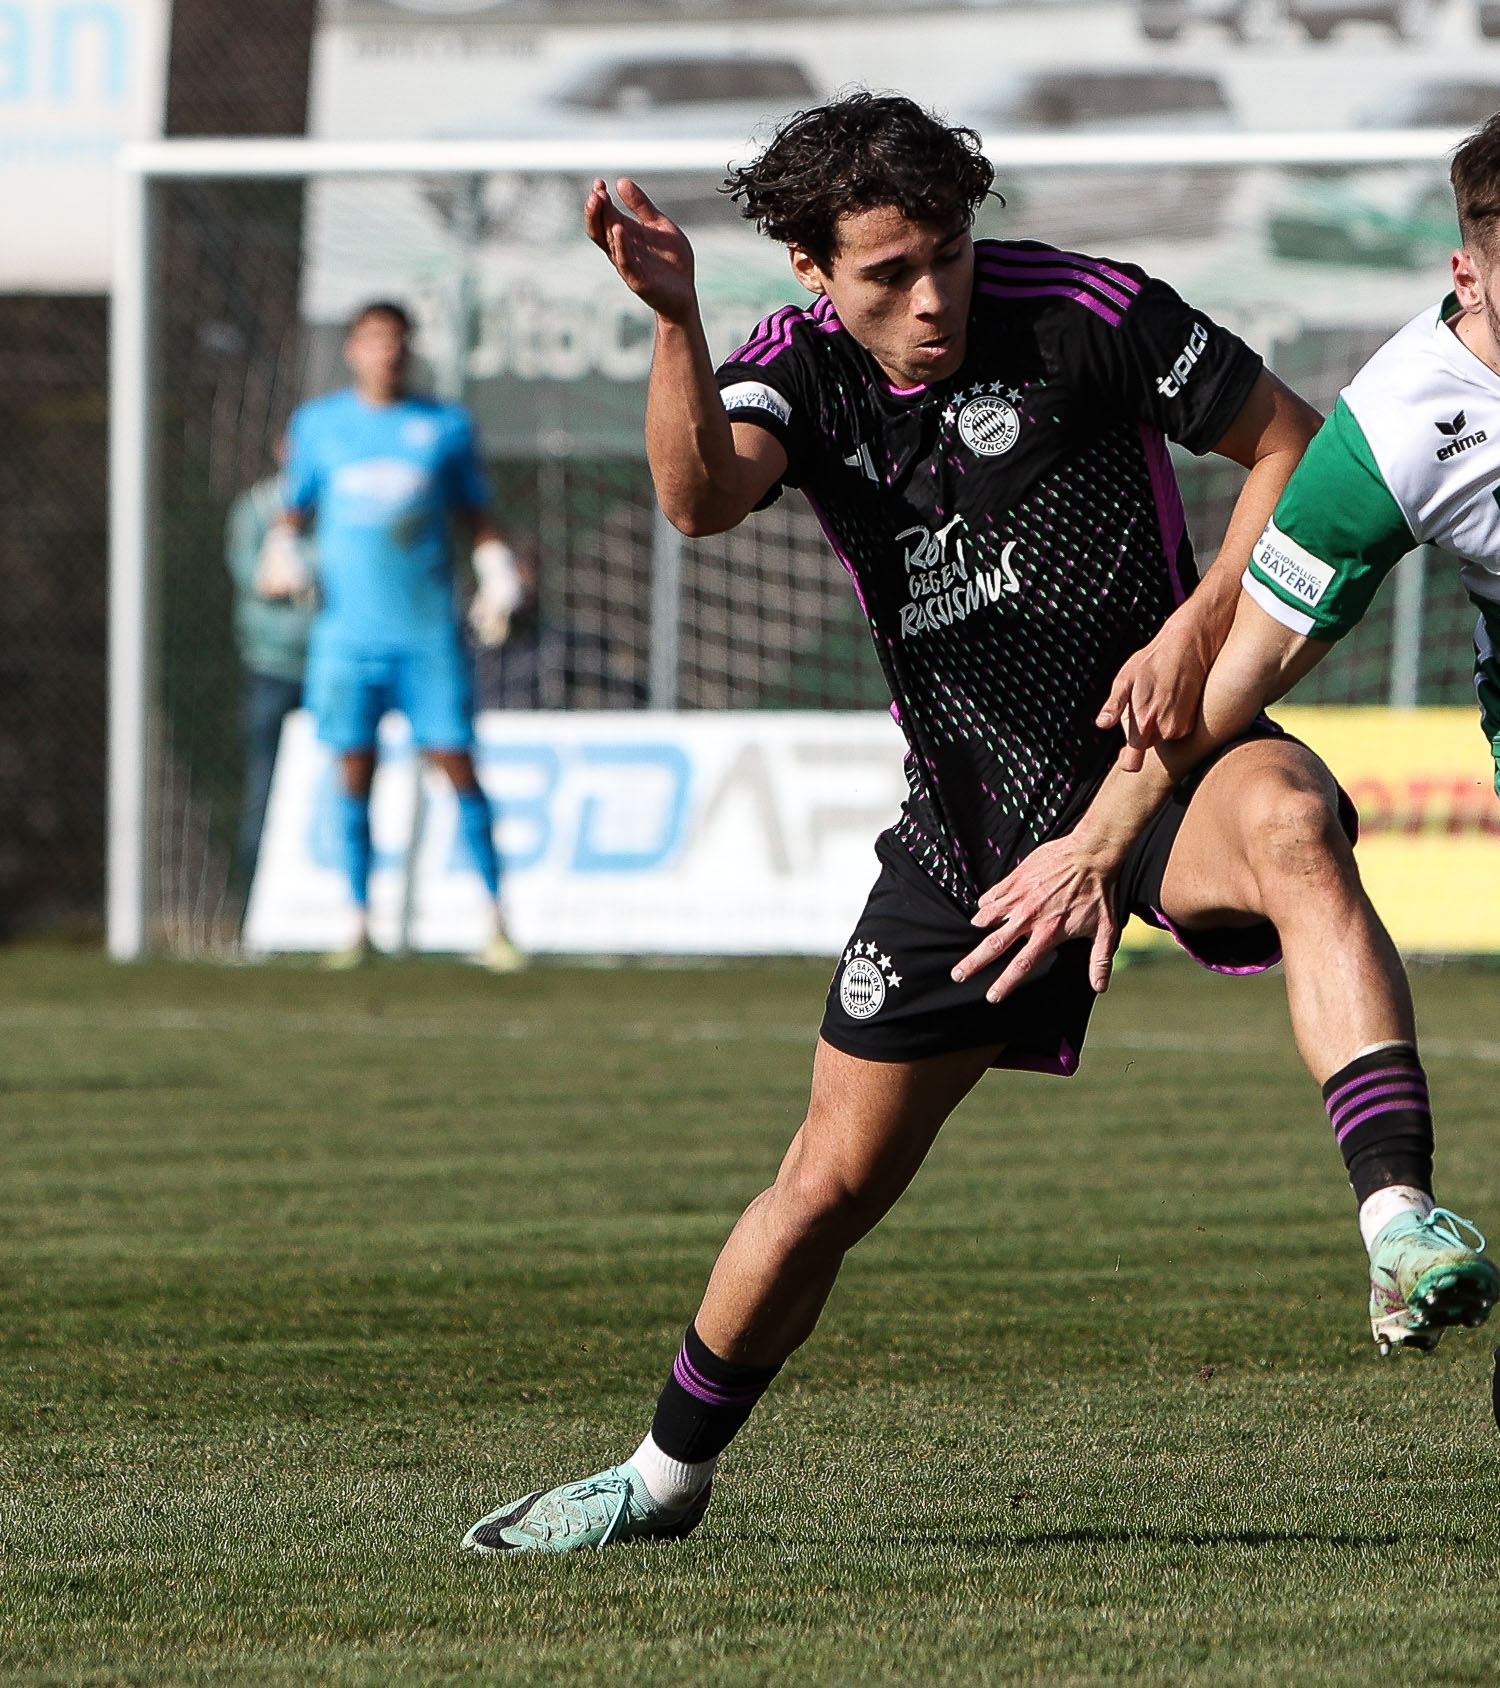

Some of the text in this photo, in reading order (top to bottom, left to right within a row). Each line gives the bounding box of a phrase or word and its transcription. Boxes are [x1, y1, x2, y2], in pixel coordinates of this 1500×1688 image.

[1156, 322, 1209, 397] tipico
[963, 400, 1010, 429] FC BAYERN
[1436, 430, 1488, 461] erima
[895, 513, 964, 573] ROT
[909, 538, 968, 599] GEGEN
[1266, 543, 1323, 589] REGIONALLIGA
[899, 541, 1020, 640] RASSISMUS
[1259, 550, 1319, 601] BAYERN
[856, 962, 881, 992] BAYERN
